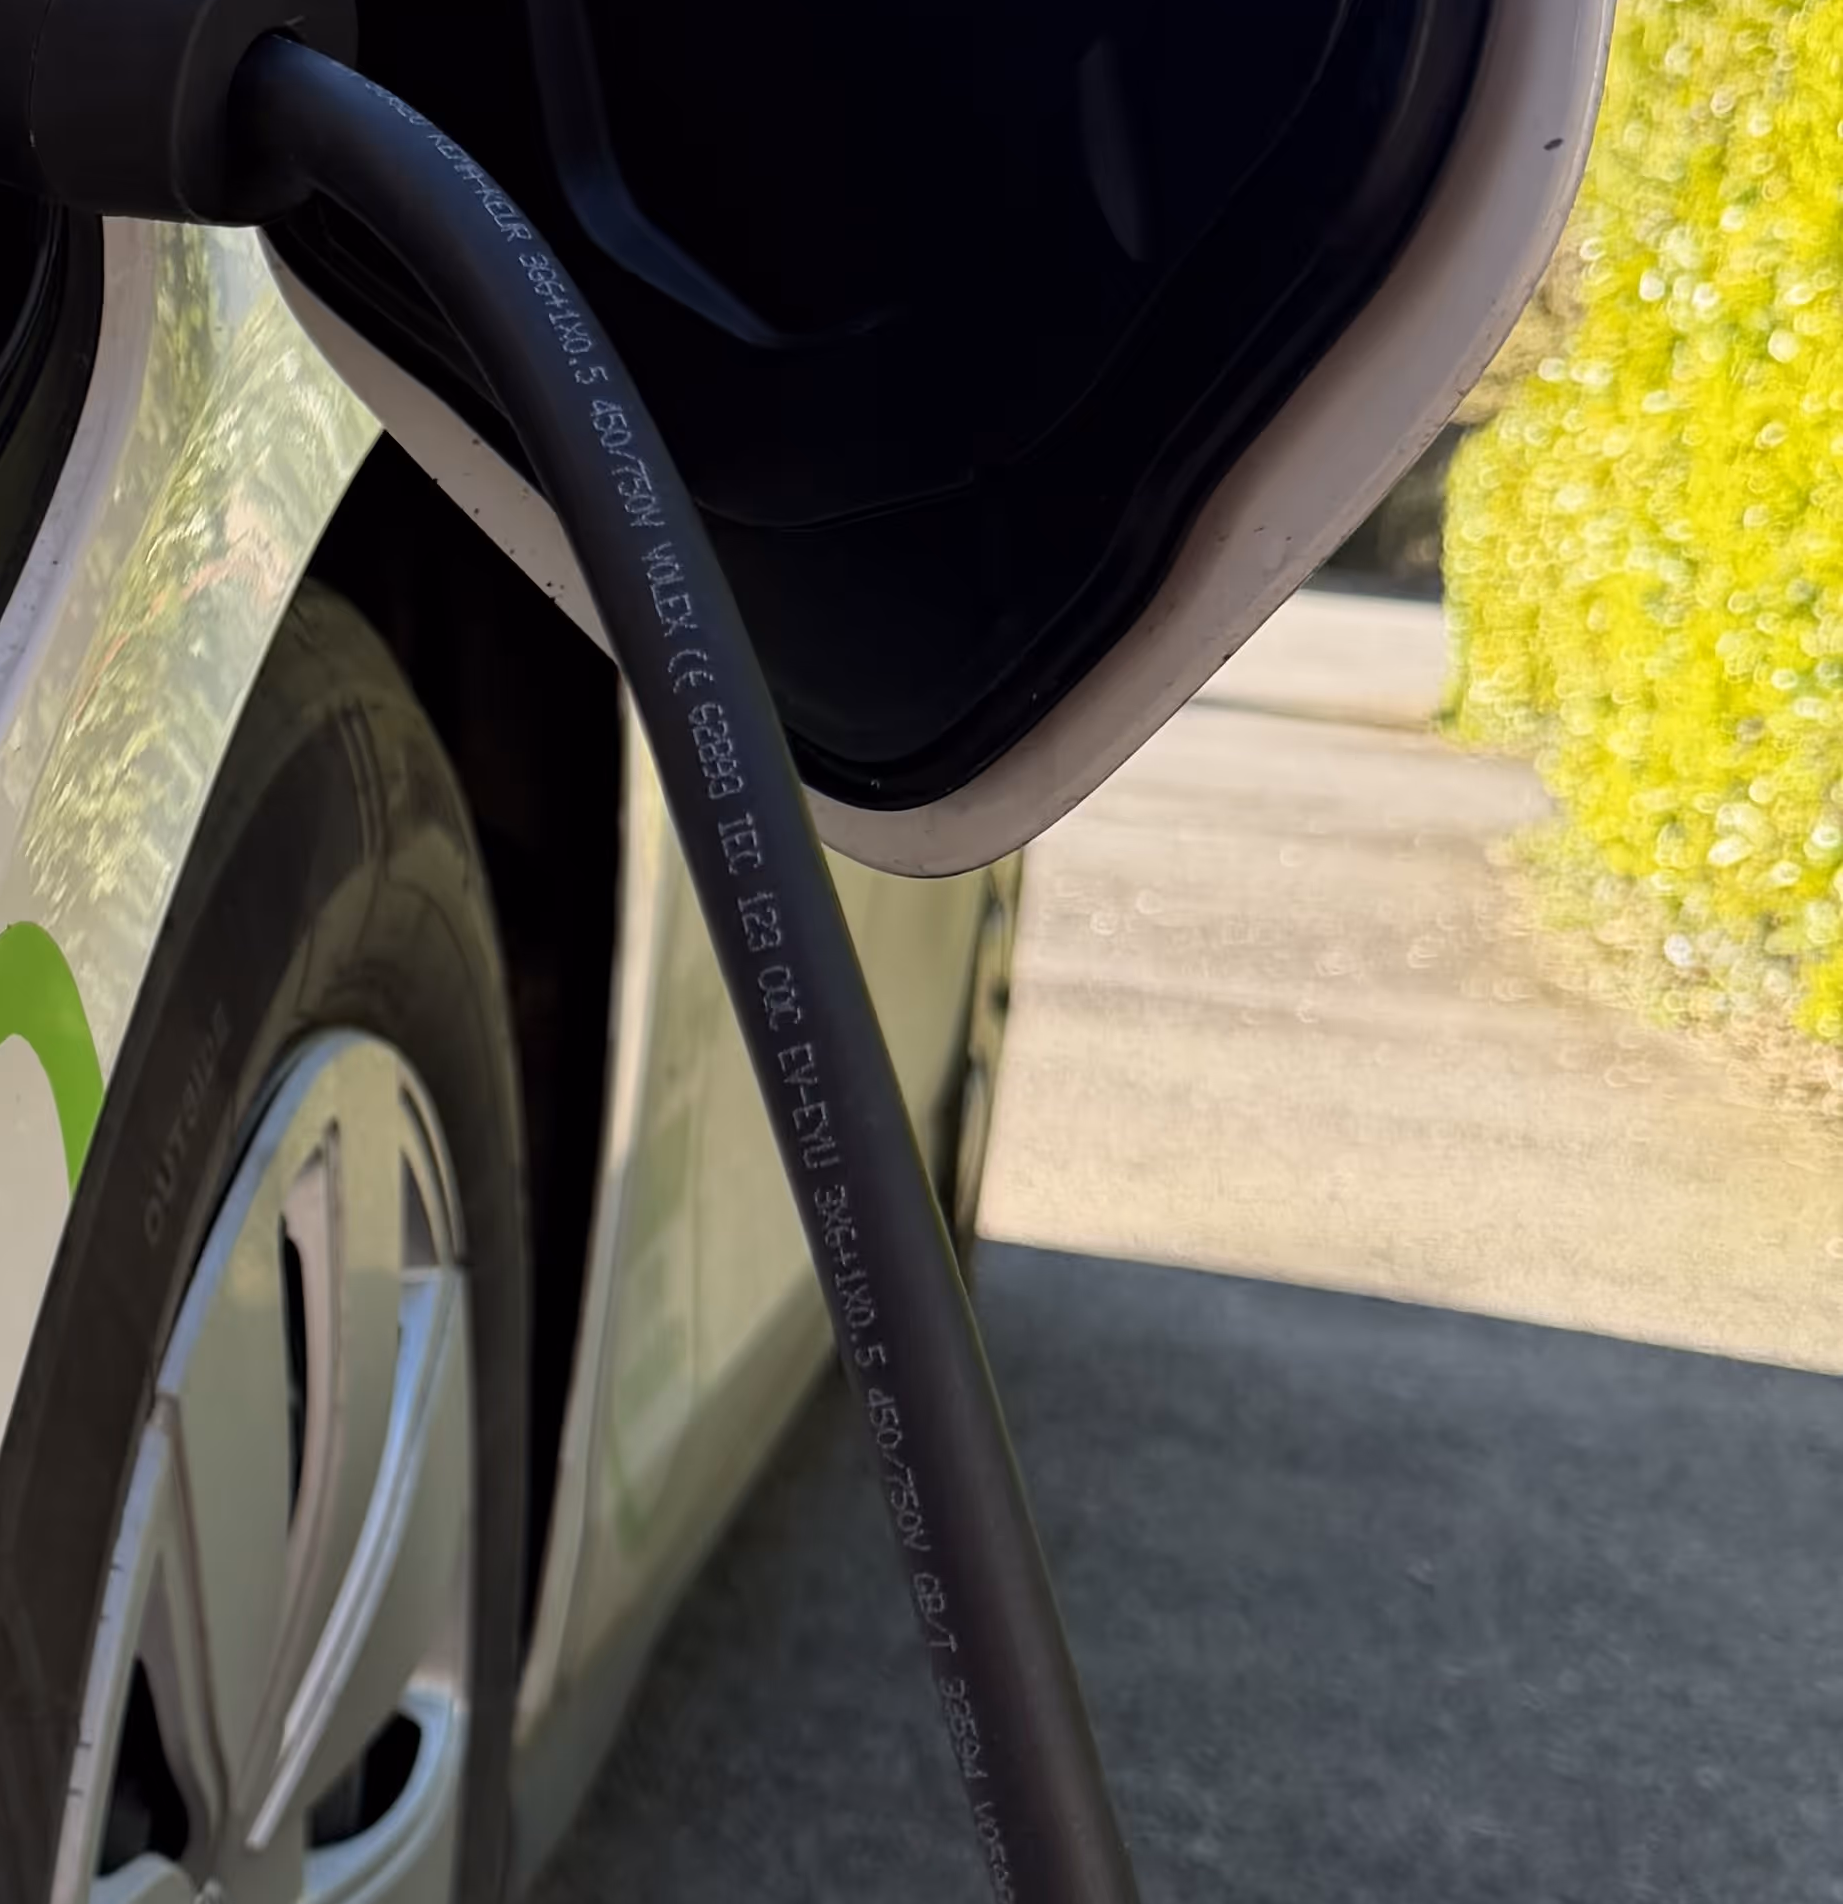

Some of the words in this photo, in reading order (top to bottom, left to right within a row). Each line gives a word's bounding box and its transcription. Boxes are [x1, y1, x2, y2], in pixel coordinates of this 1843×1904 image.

[641, 540, 699, 637] VOLEX
[718, 811, 763, 876] IEC
[737, 891, 782, 952] 123
